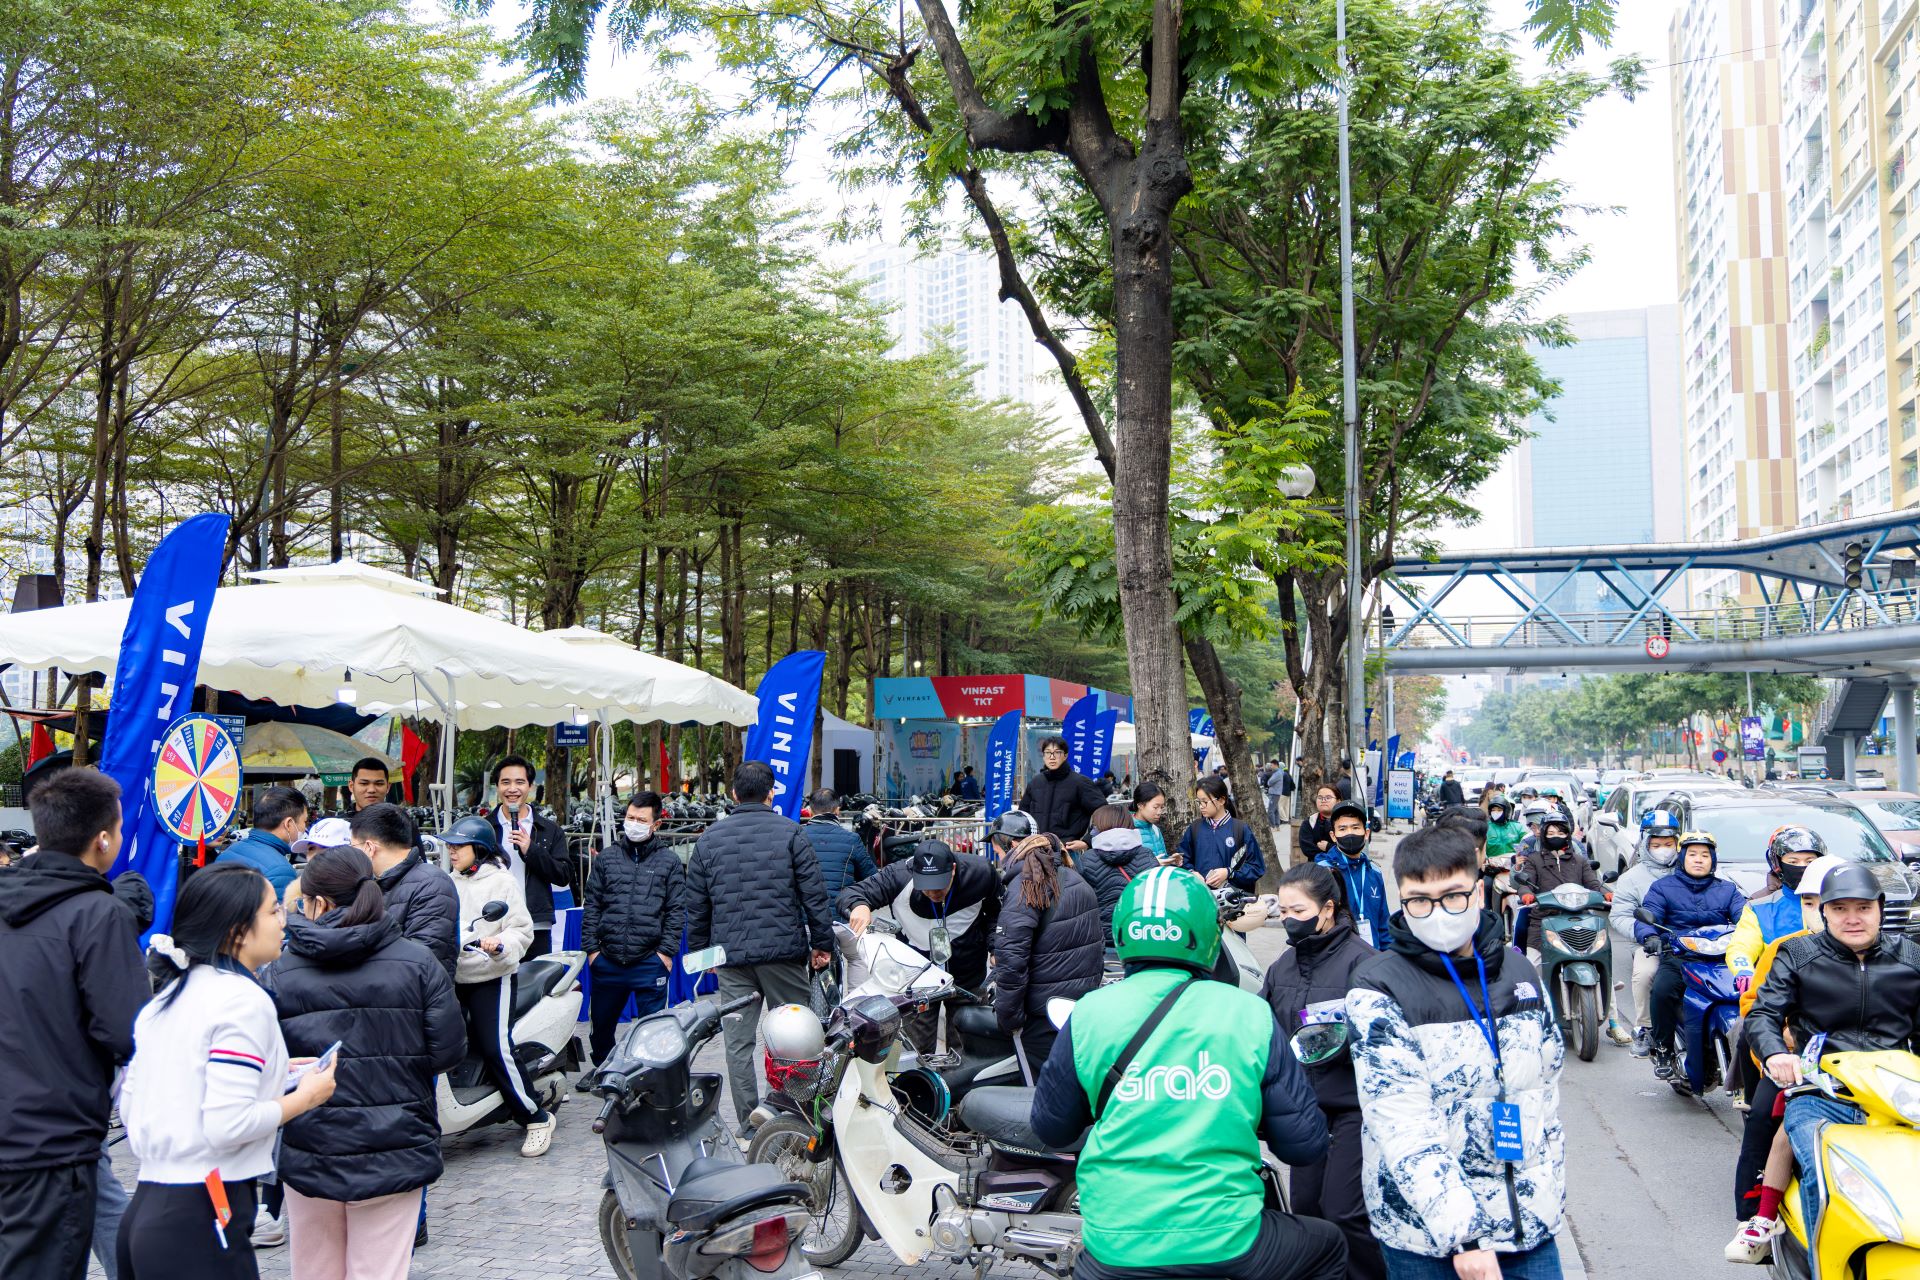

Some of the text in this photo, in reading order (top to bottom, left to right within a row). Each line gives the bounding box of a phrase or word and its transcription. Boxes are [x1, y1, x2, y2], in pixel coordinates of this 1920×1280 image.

[961, 686, 1005, 695] VINFAST
[974, 697, 993, 706] TKT
[1003, 749, 1012, 772] PHÁT
[992, 740, 1004, 810] VINFAST
[1128, 918, 1182, 942] Grab
[1114, 1050, 1232, 1102] Grab
[1007, 1145, 1042, 1157] HONDA
